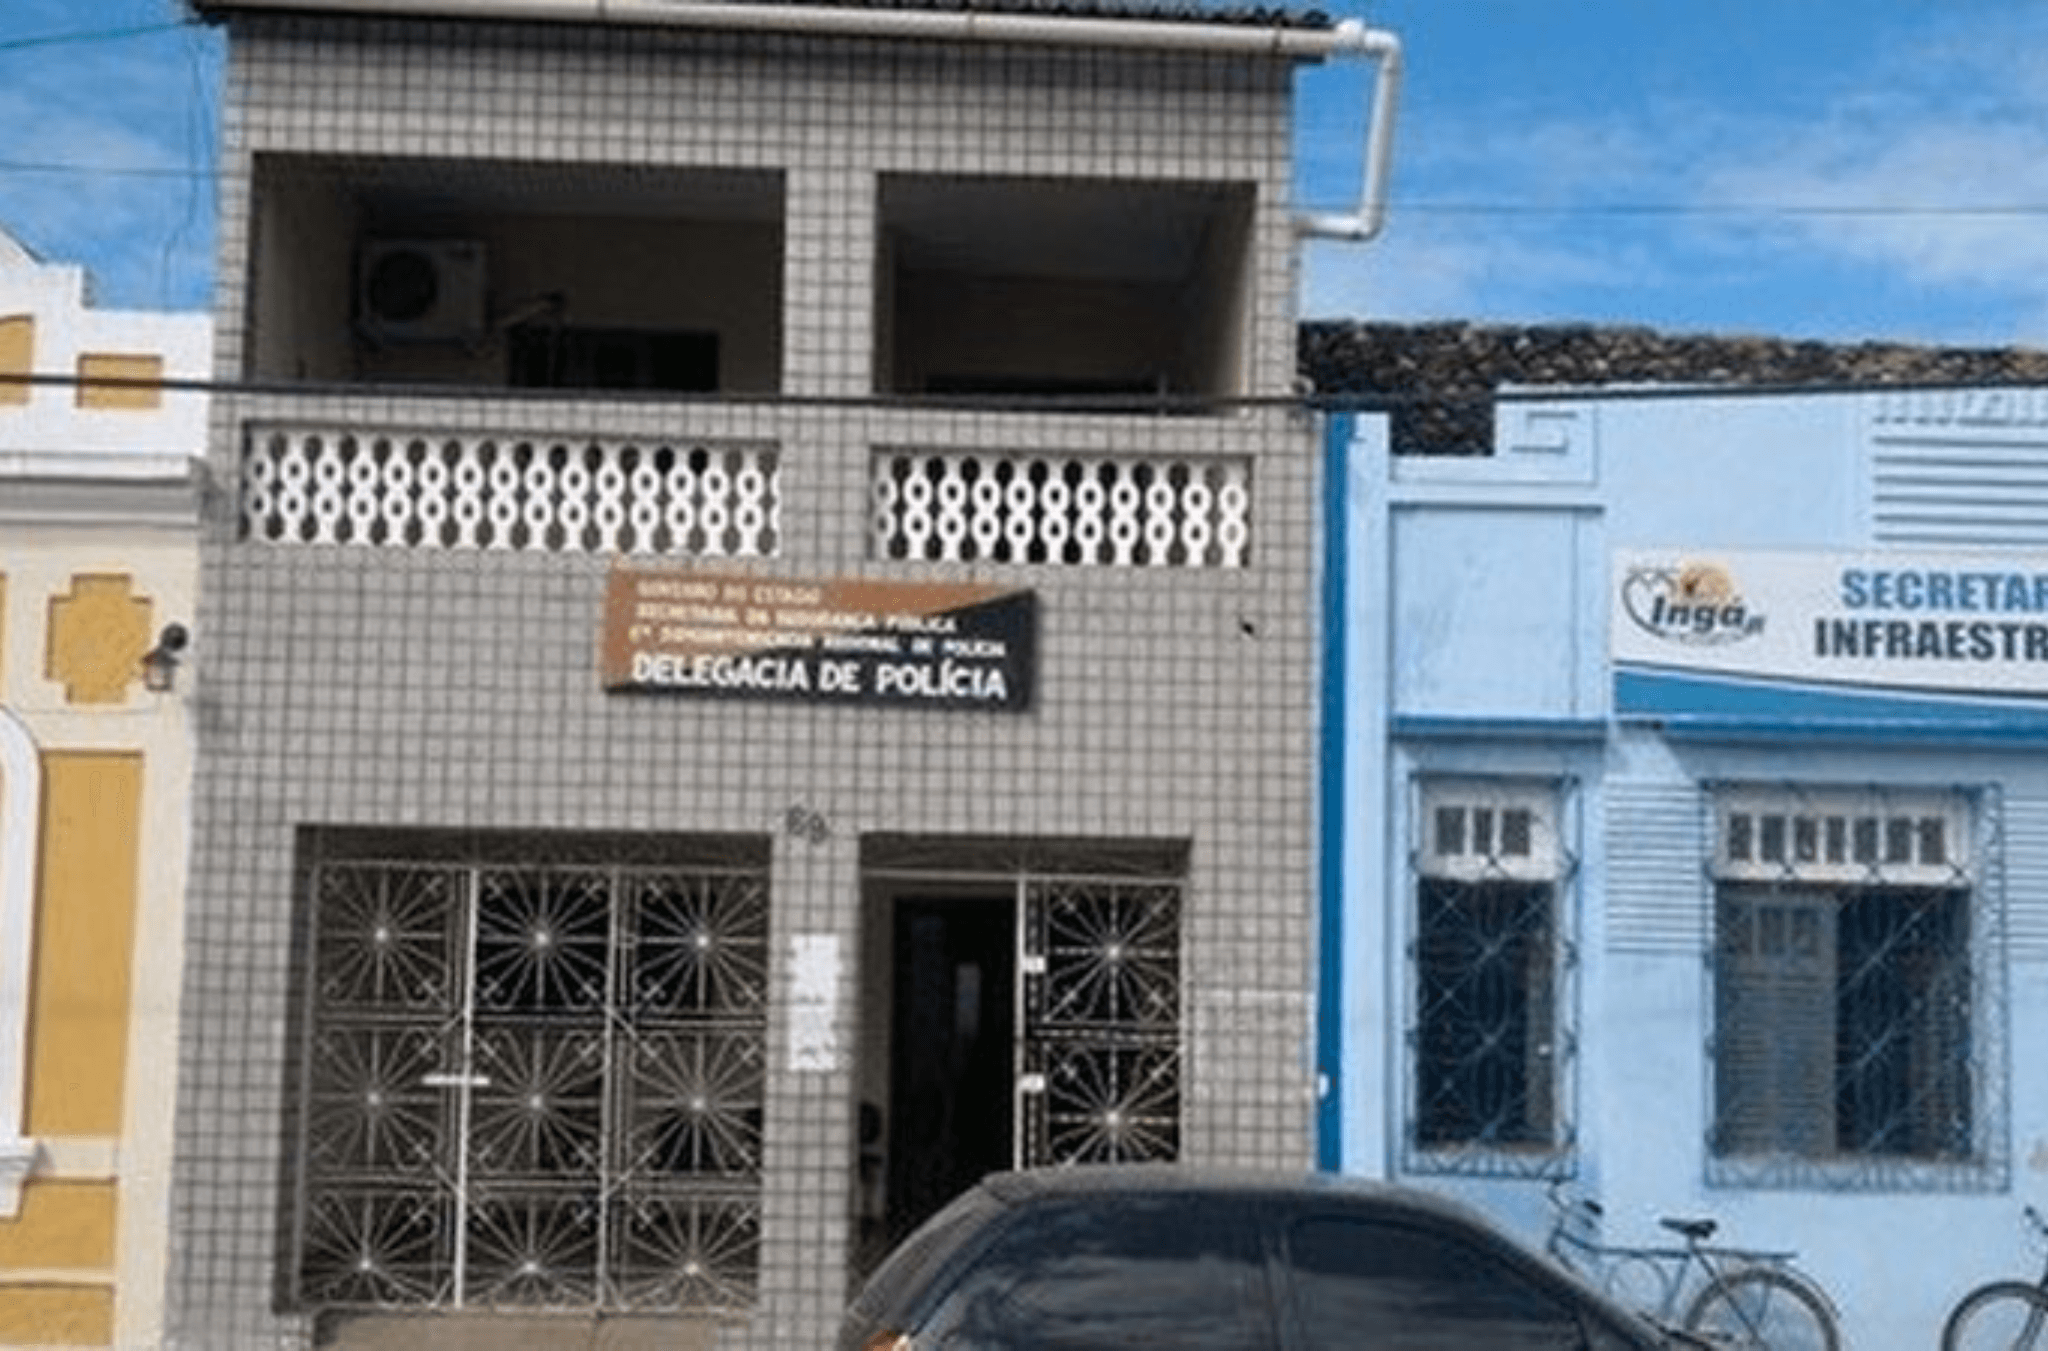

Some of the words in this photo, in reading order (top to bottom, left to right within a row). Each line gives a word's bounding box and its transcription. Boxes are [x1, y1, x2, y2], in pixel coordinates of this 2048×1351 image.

[1651, 595, 1746, 633] Ingá
[1815, 618, 2048, 660] INFRAESTR
[632, 651, 808, 689] DELEGACIA
[820, 660, 861, 693] DE
[876, 657, 1008, 700] POLÍCIA
